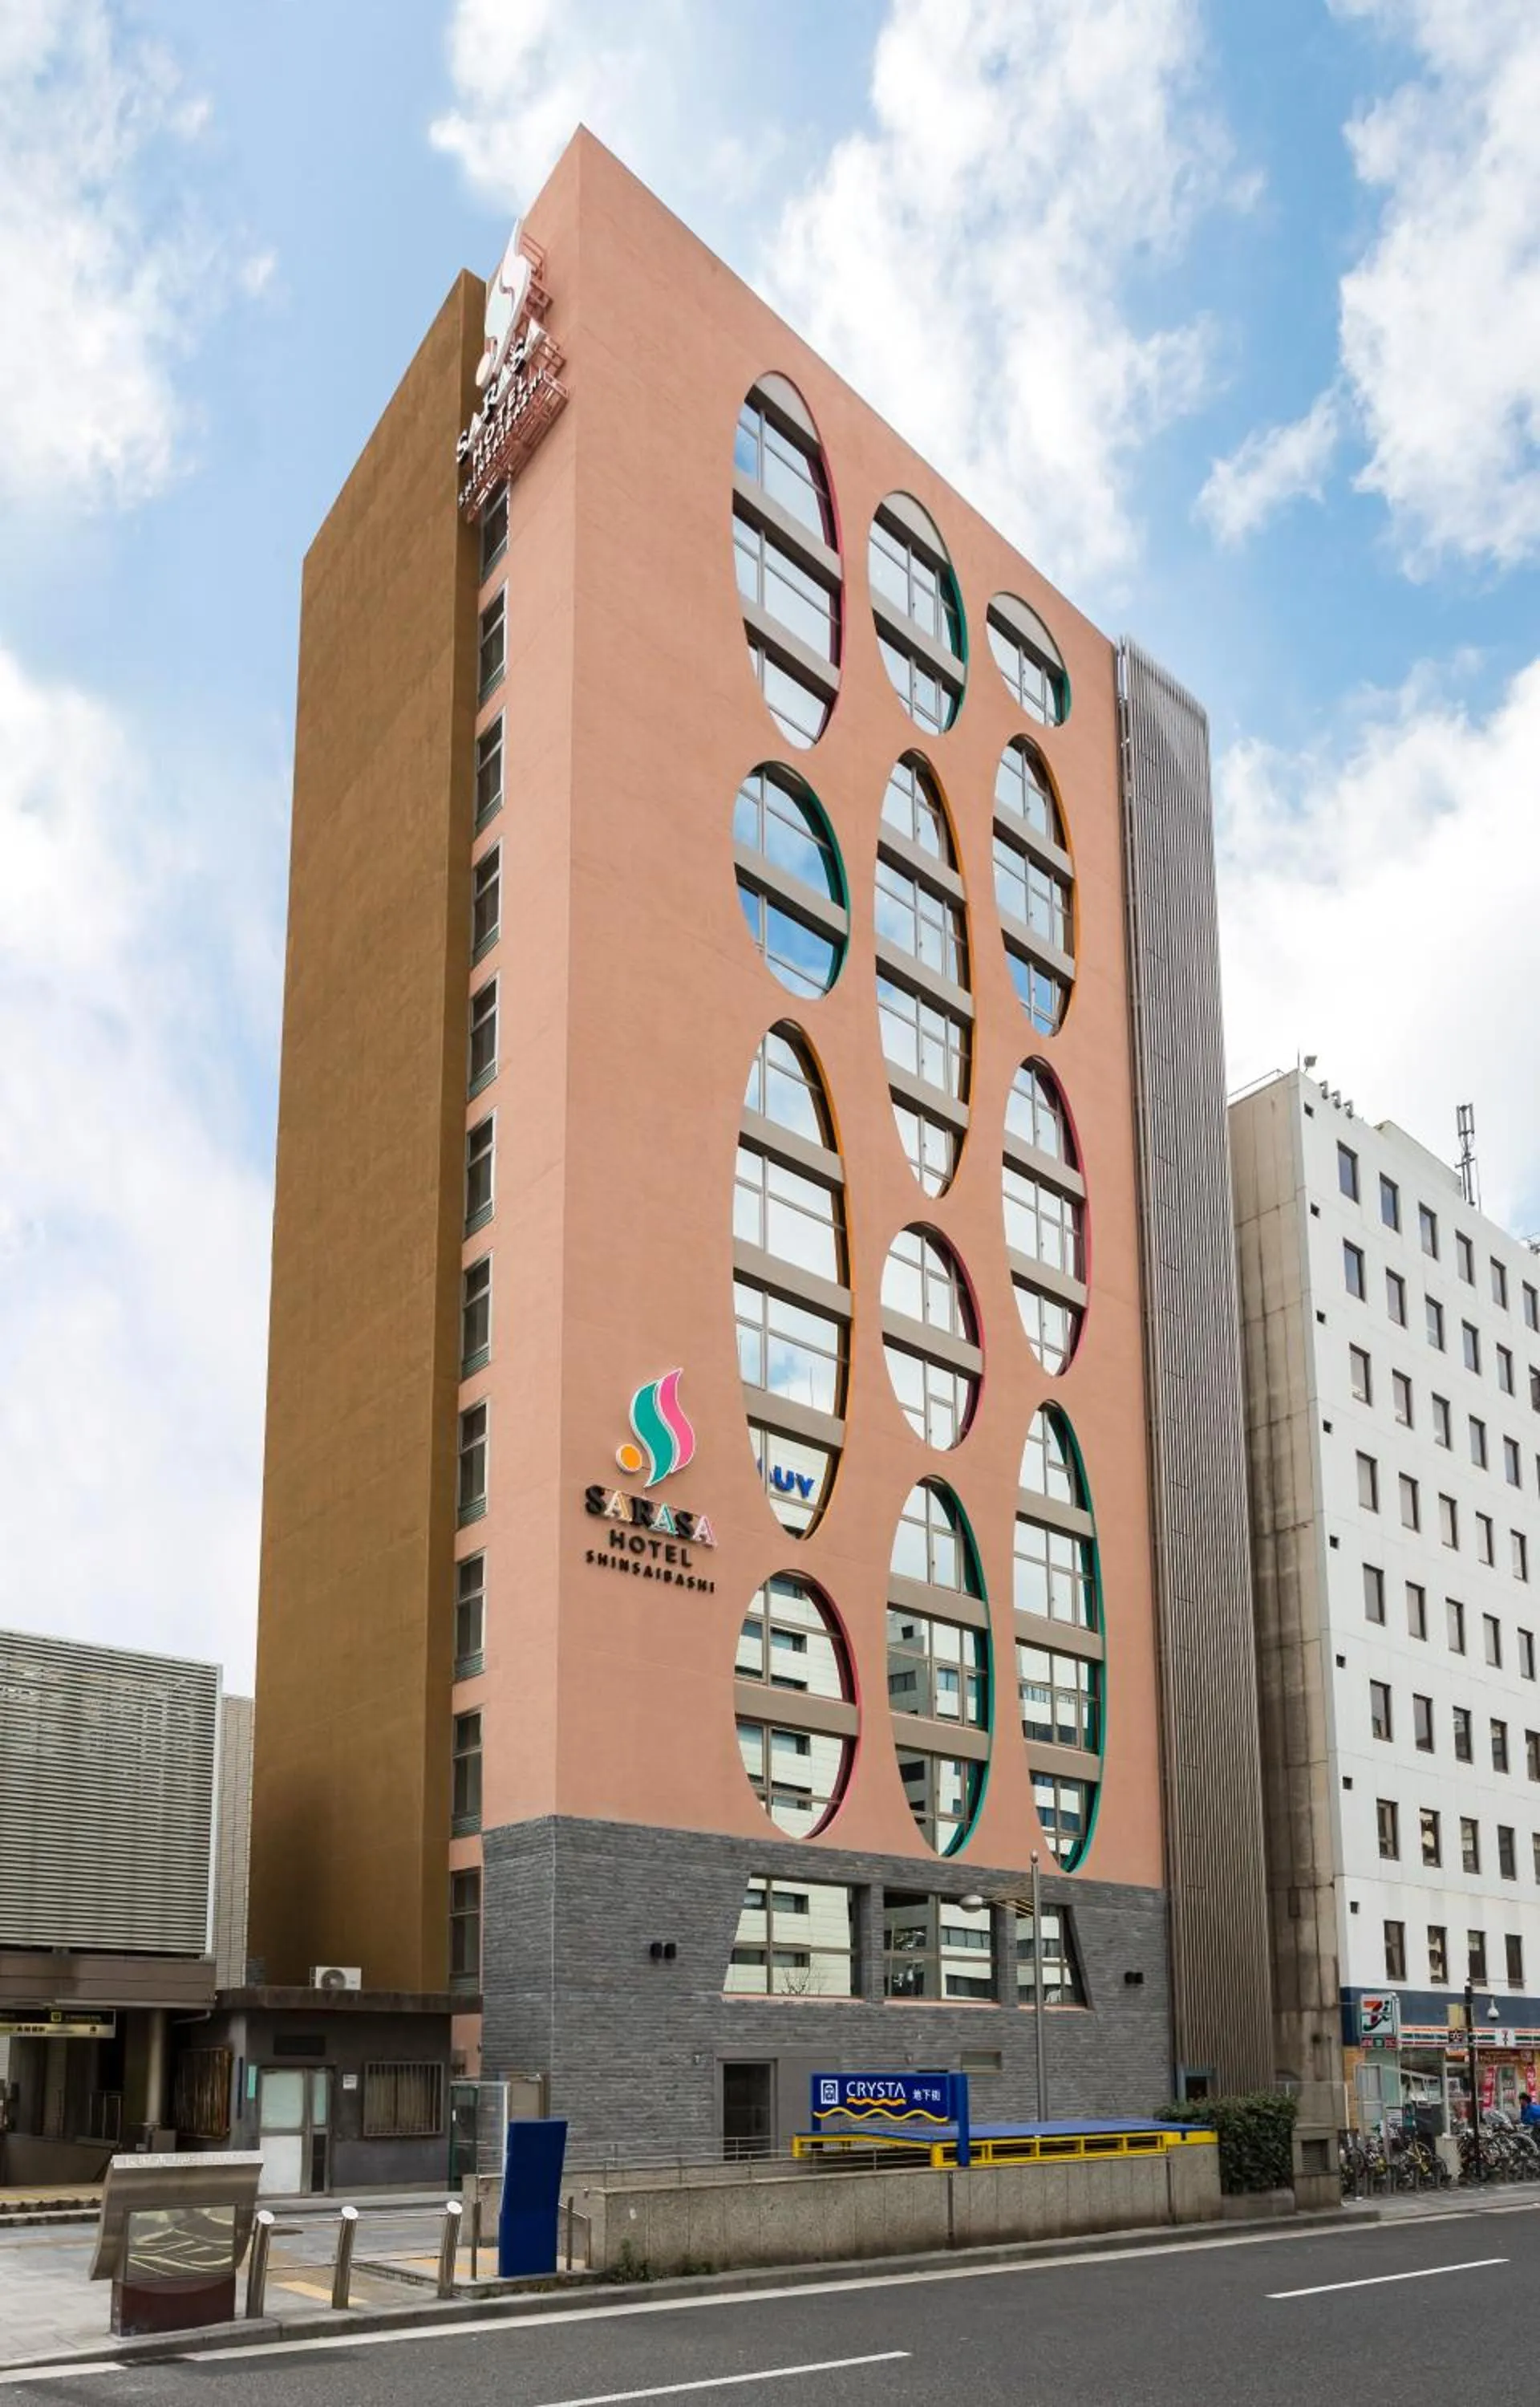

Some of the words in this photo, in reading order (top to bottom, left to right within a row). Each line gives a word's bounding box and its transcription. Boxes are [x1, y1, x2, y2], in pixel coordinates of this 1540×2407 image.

[472, 374, 527, 467] HOTEL
[585, 1484, 718, 1549] SARASA
[610, 1528, 692, 1569] HOTEL
[586, 1549, 715, 1593] SHINSAIBASHI
[846, 2081, 906, 2098] CRYSTA
